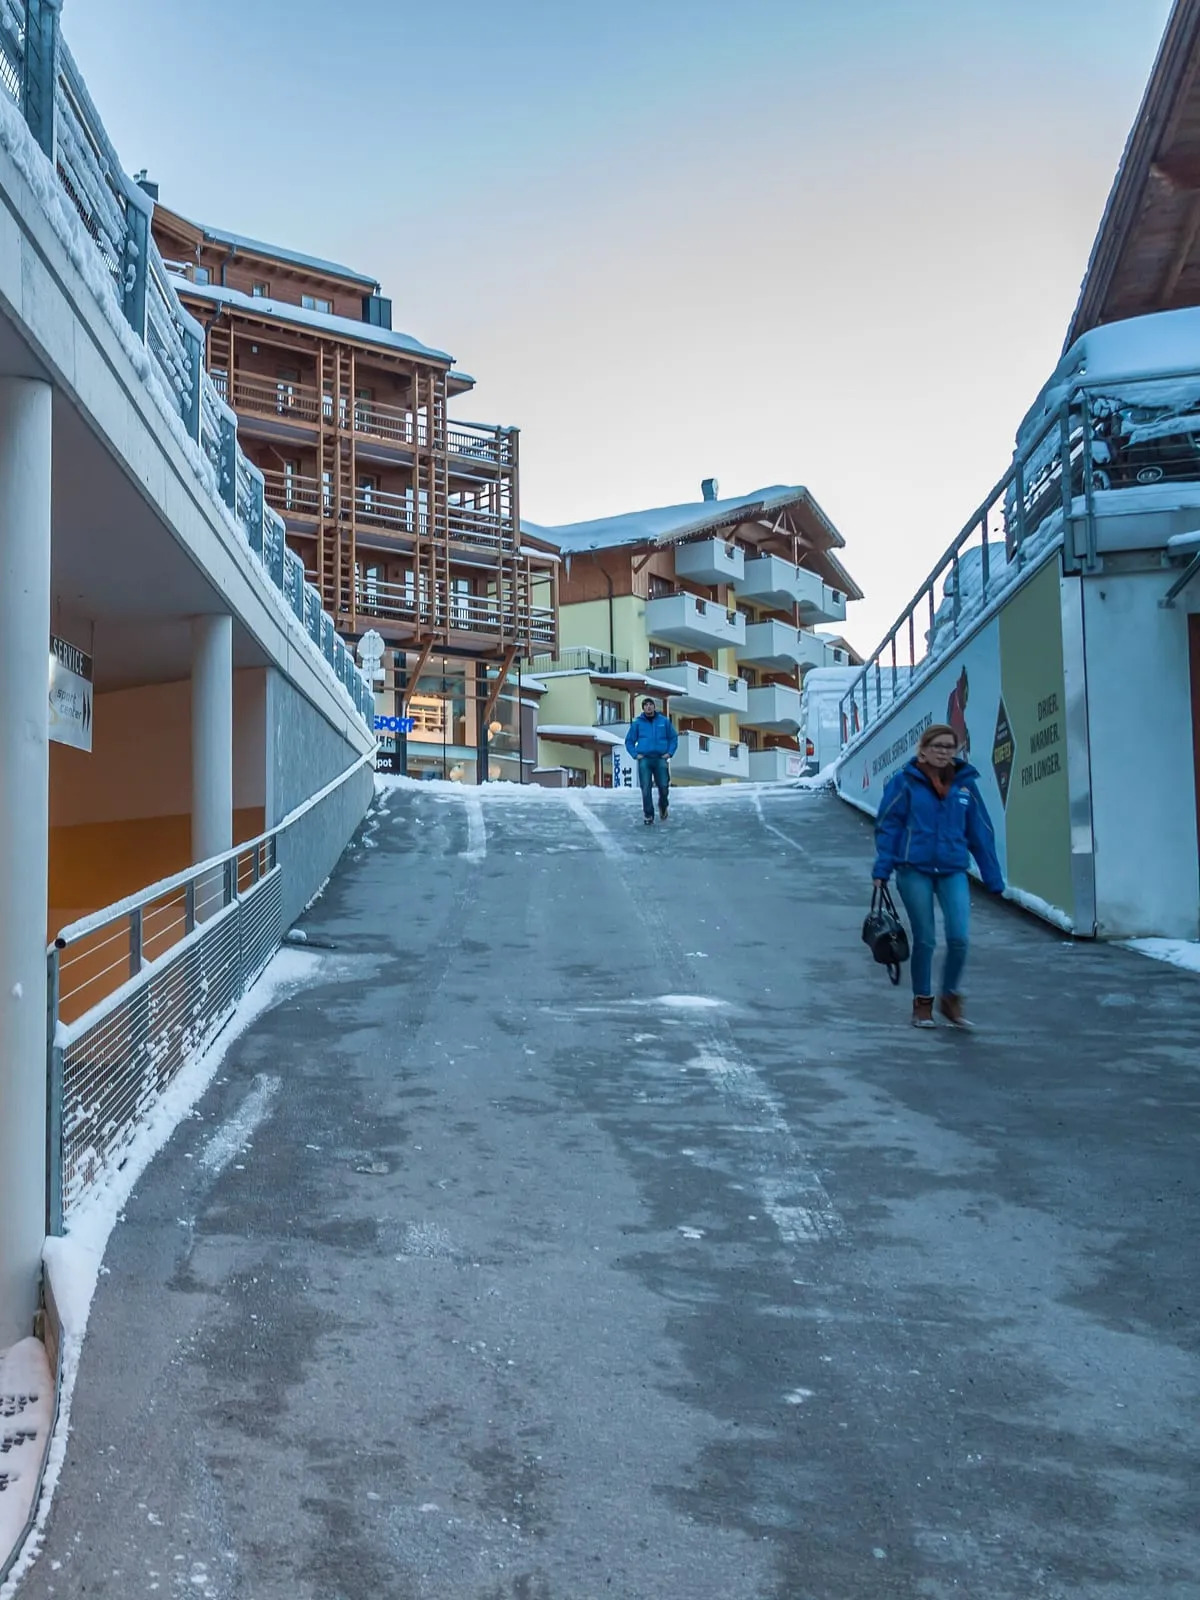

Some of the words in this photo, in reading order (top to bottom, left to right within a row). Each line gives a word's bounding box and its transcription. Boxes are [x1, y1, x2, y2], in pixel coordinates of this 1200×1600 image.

[53, 638, 84, 675] SERVICE
[56, 688, 77, 705] sport
[1029, 722, 1060, 755] WARMER.
[1021, 765, 1034, 788] FOR
[1033, 752, 1061, 782] LONGER.
